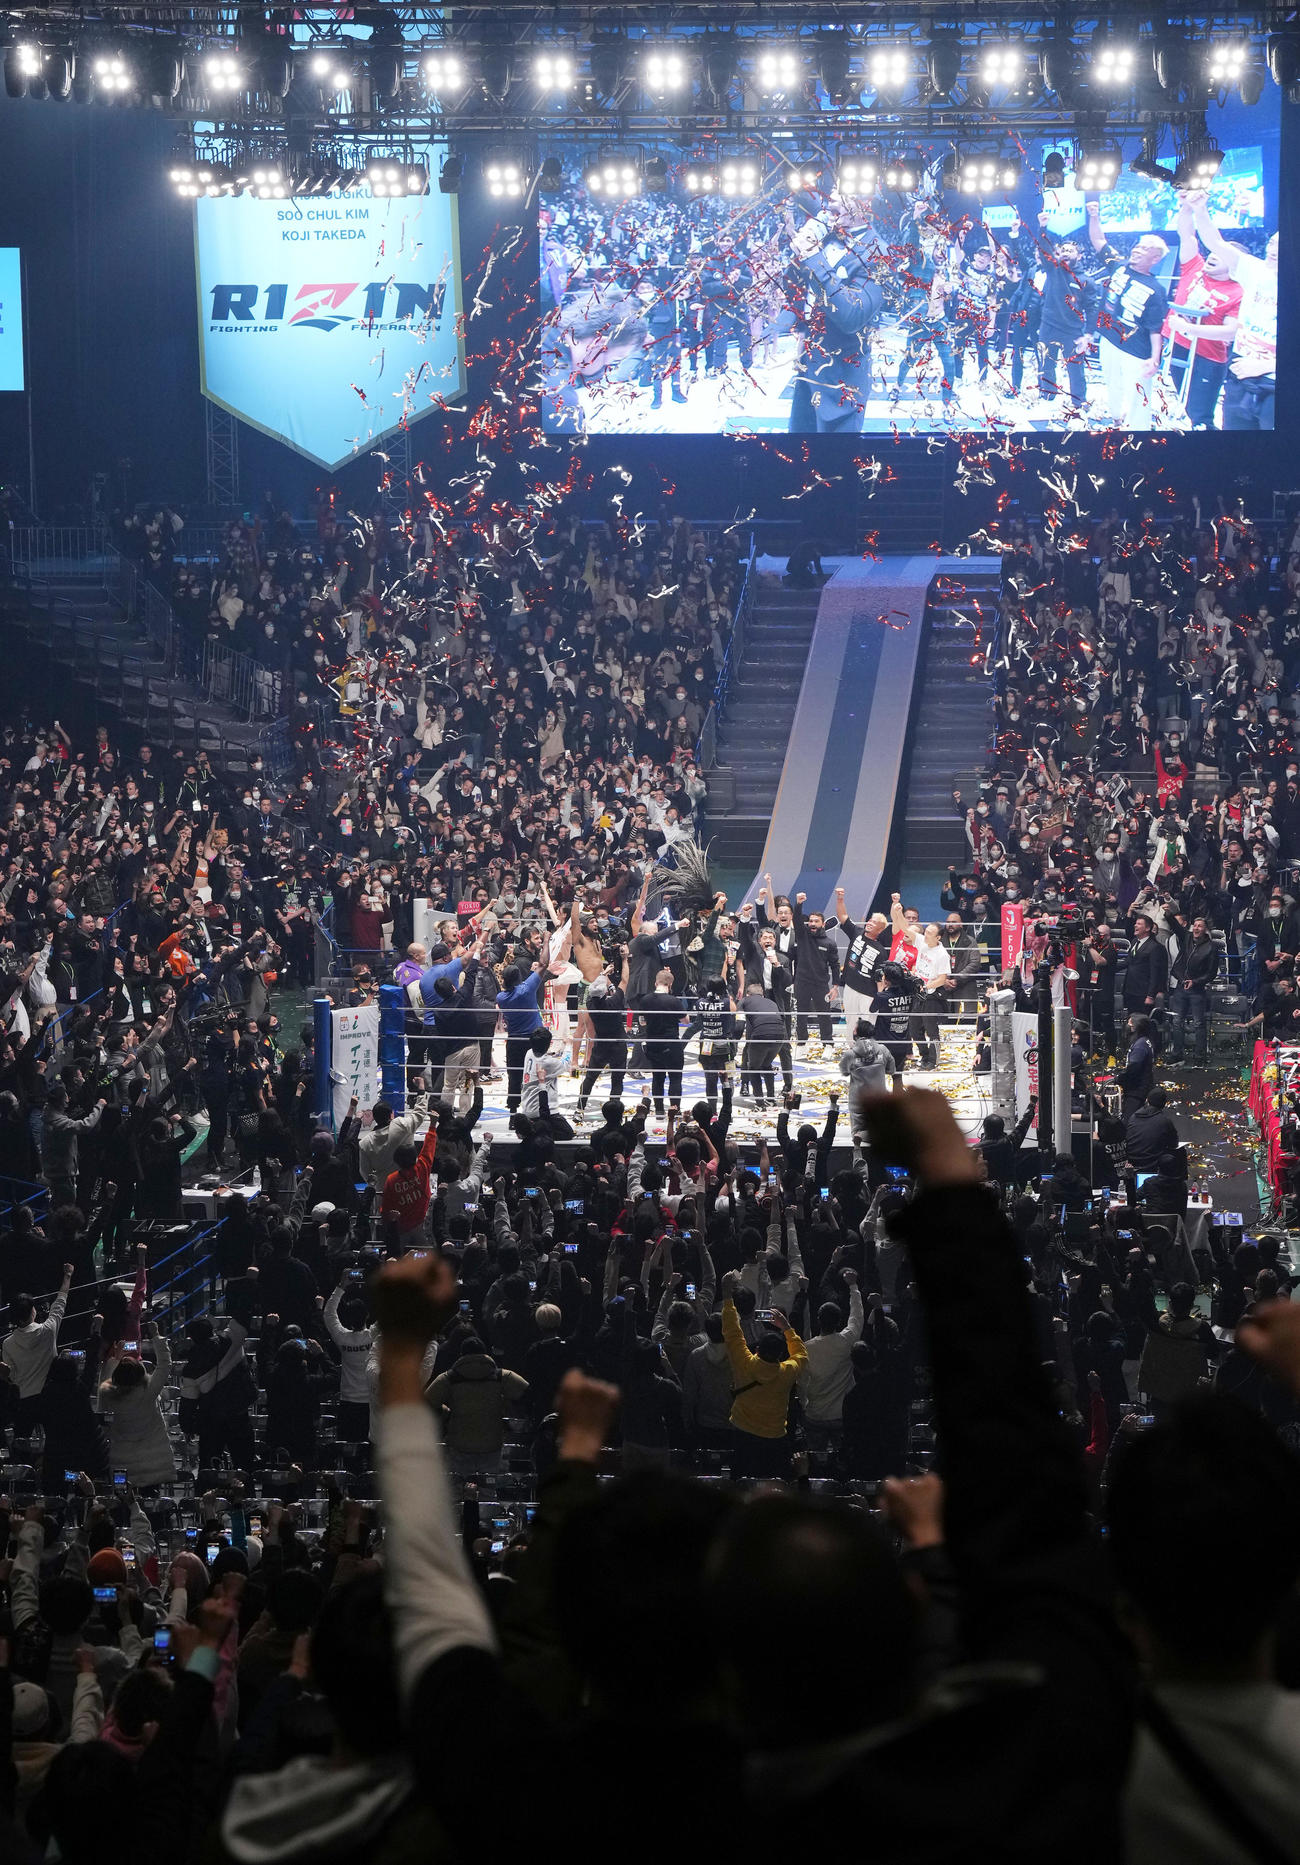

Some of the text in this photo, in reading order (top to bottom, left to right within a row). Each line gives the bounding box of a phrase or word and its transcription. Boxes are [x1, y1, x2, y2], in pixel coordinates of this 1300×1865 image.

[277, 208, 369, 221] SOO CHUL KIM
[282, 229, 366, 241] KOJI TAKEDA
[209, 282, 447, 325] RIZIN
[209, 325, 278, 333] FIGHTING
[698, 1001, 724, 1011] STAFF
[888, 995, 912, 1007] STAFF
[340, 1031, 371, 1040] IMPROVE
